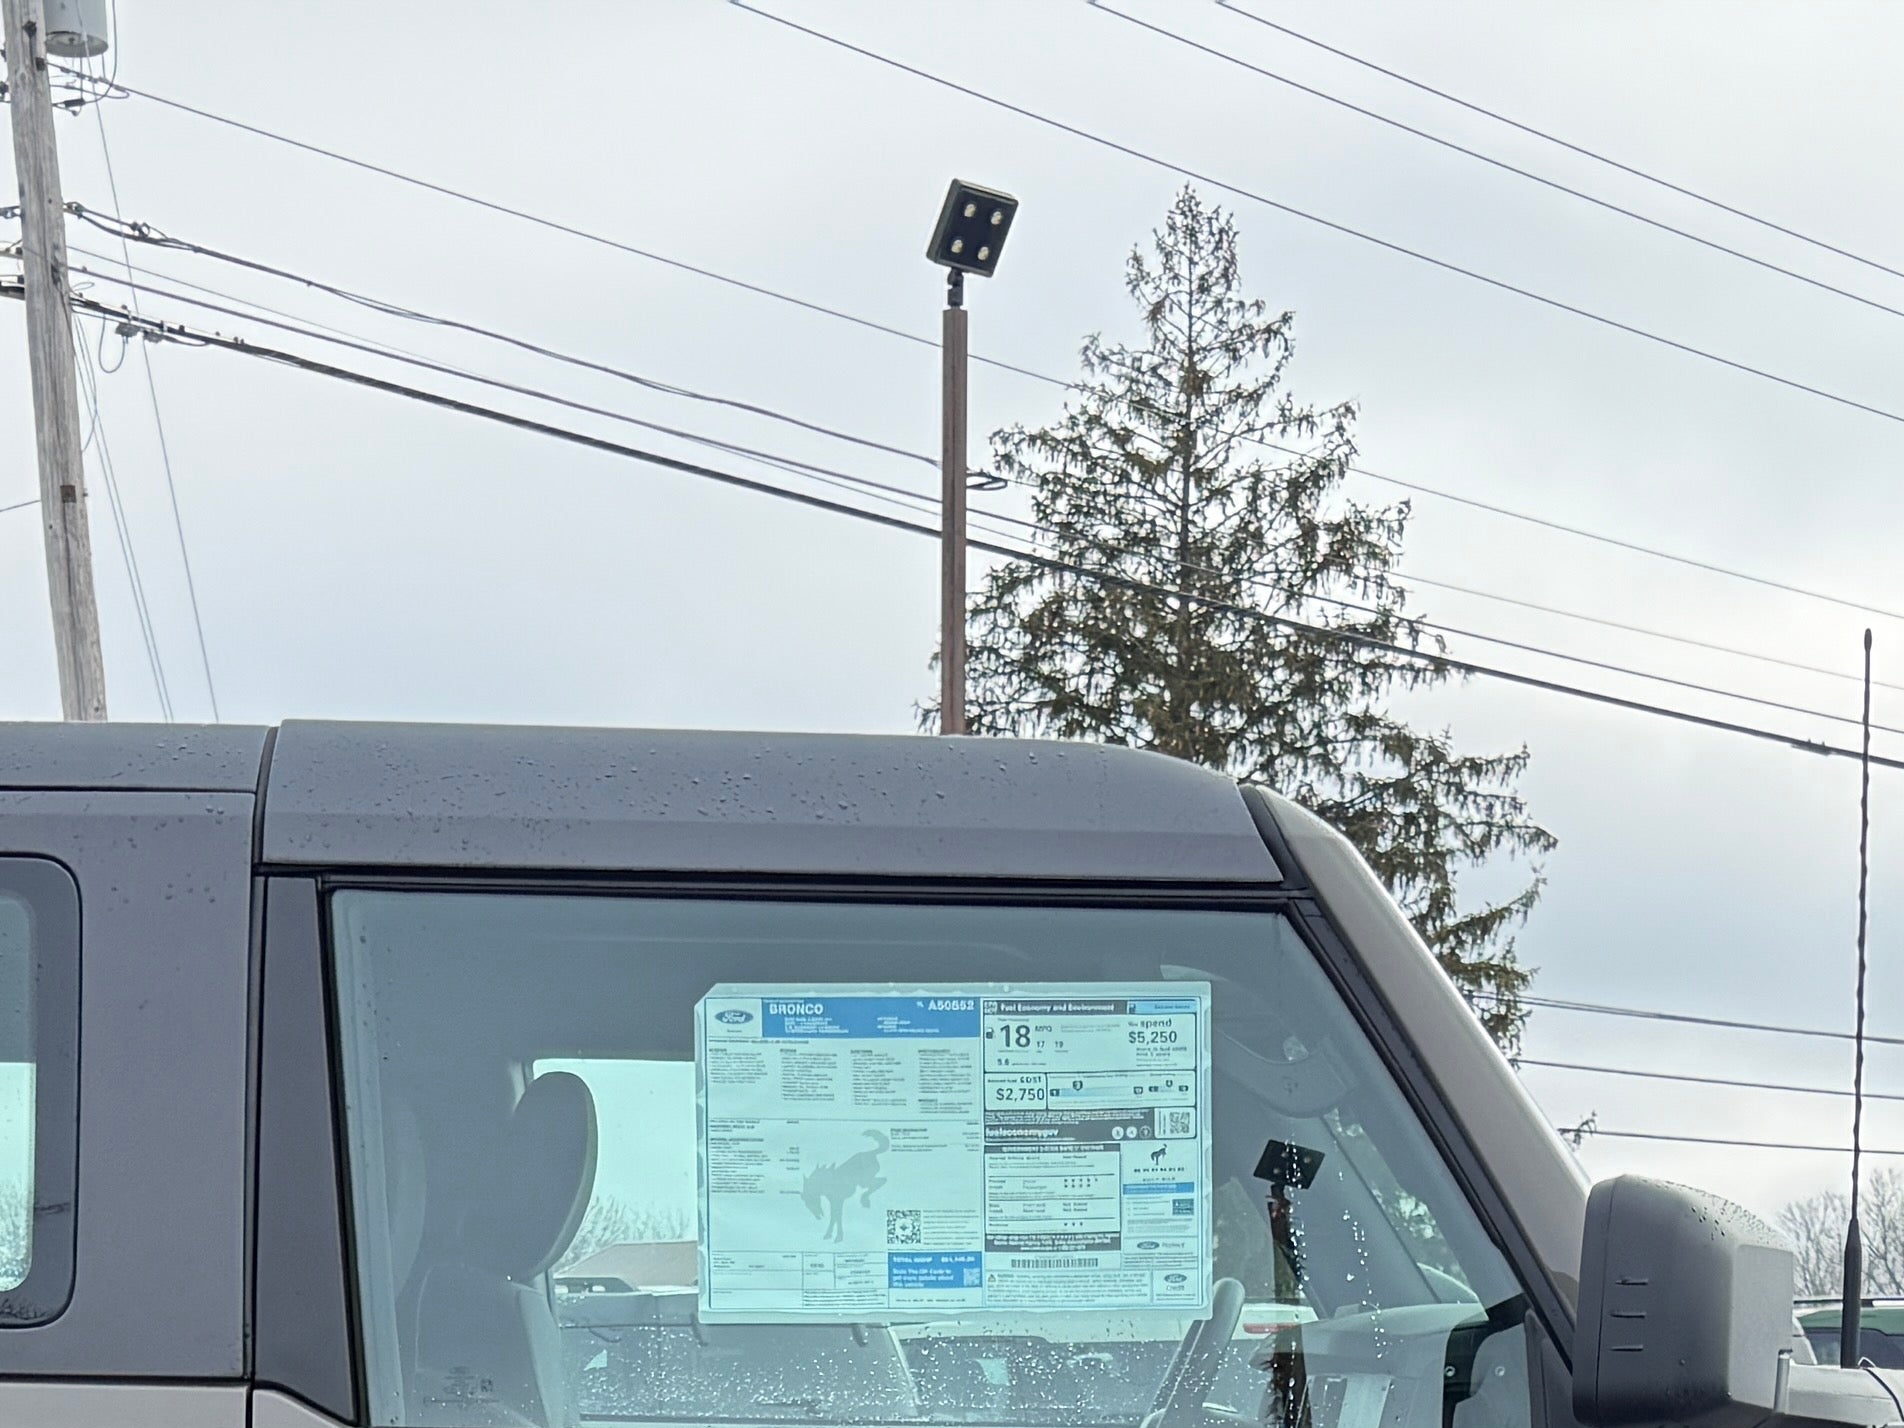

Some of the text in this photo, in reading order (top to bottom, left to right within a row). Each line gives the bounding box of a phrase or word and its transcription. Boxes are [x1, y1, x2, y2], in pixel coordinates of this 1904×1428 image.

[769, 1003, 824, 1015] BRONCO
[1000, 1003, 1016, 1012] Fuel
[1140, 1018, 1172, 1029] spend
[1000, 1024, 1031, 1048] 18
[1128, 1030, 1178, 1045] $5,250
[996, 1087, 1045, 1102] $2,750
